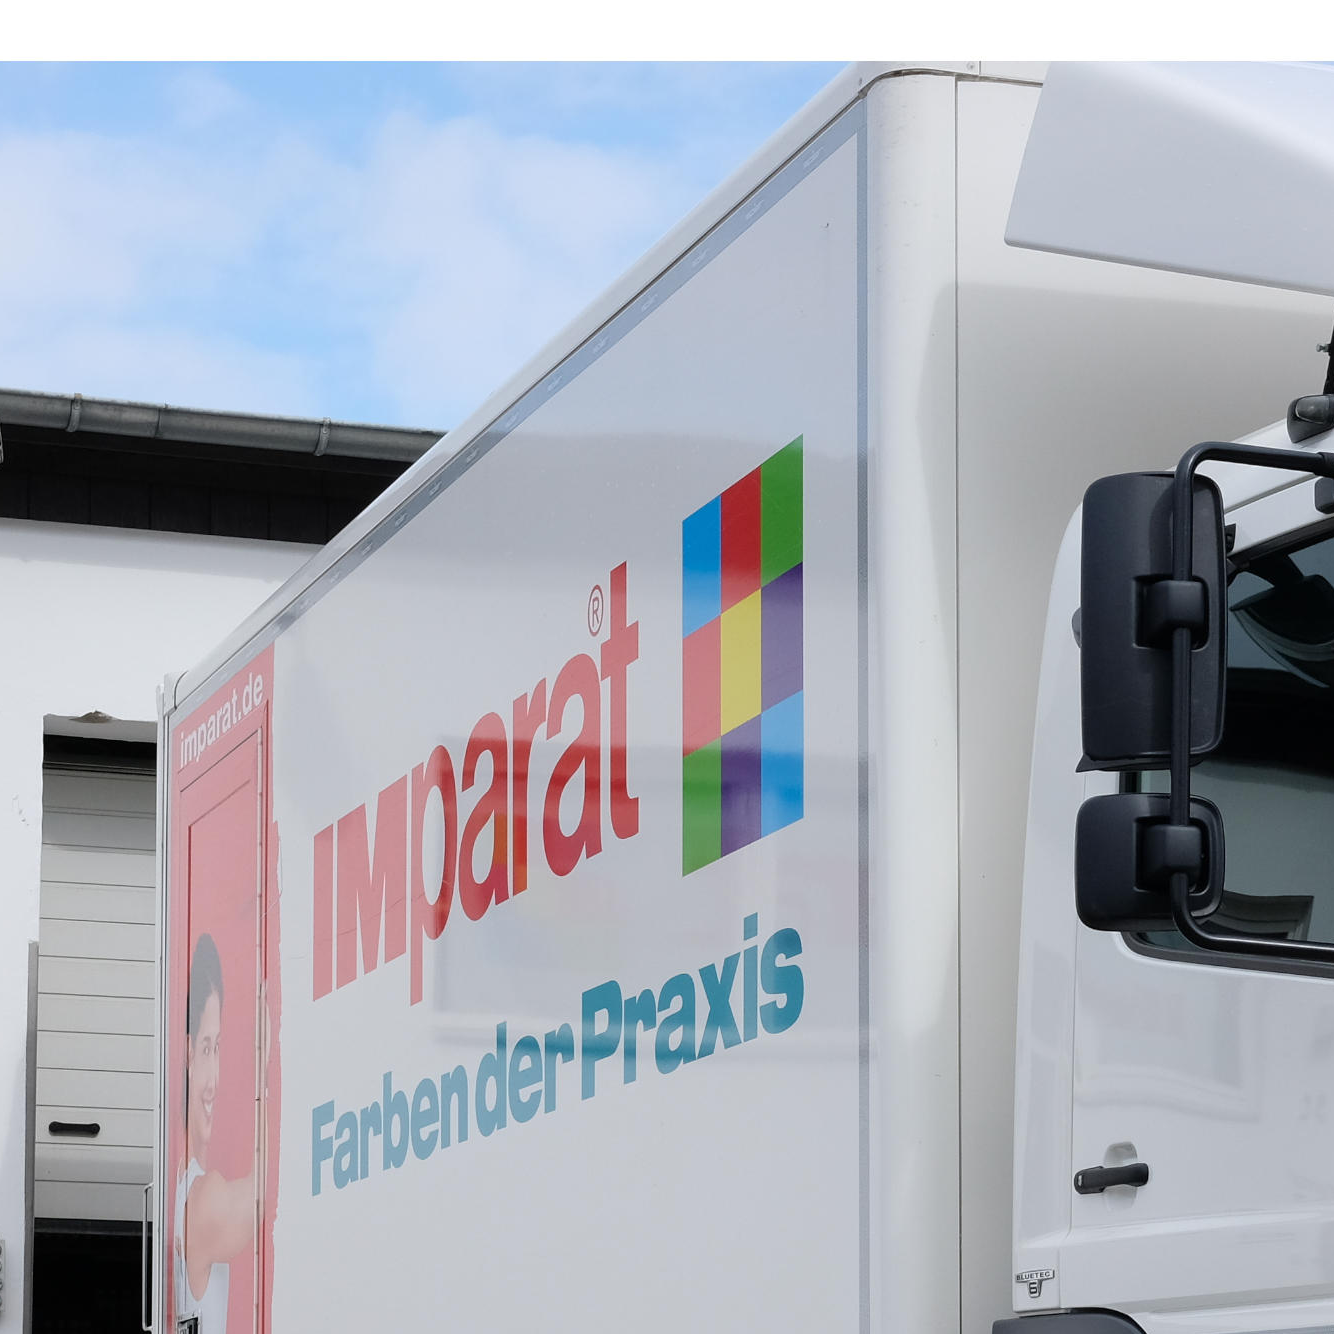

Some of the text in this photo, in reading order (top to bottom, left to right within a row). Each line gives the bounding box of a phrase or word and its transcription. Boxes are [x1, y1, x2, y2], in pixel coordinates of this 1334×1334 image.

[180, 672, 264, 769] imparat.de
[312, 912, 806, 1197] Farben der Praxis
